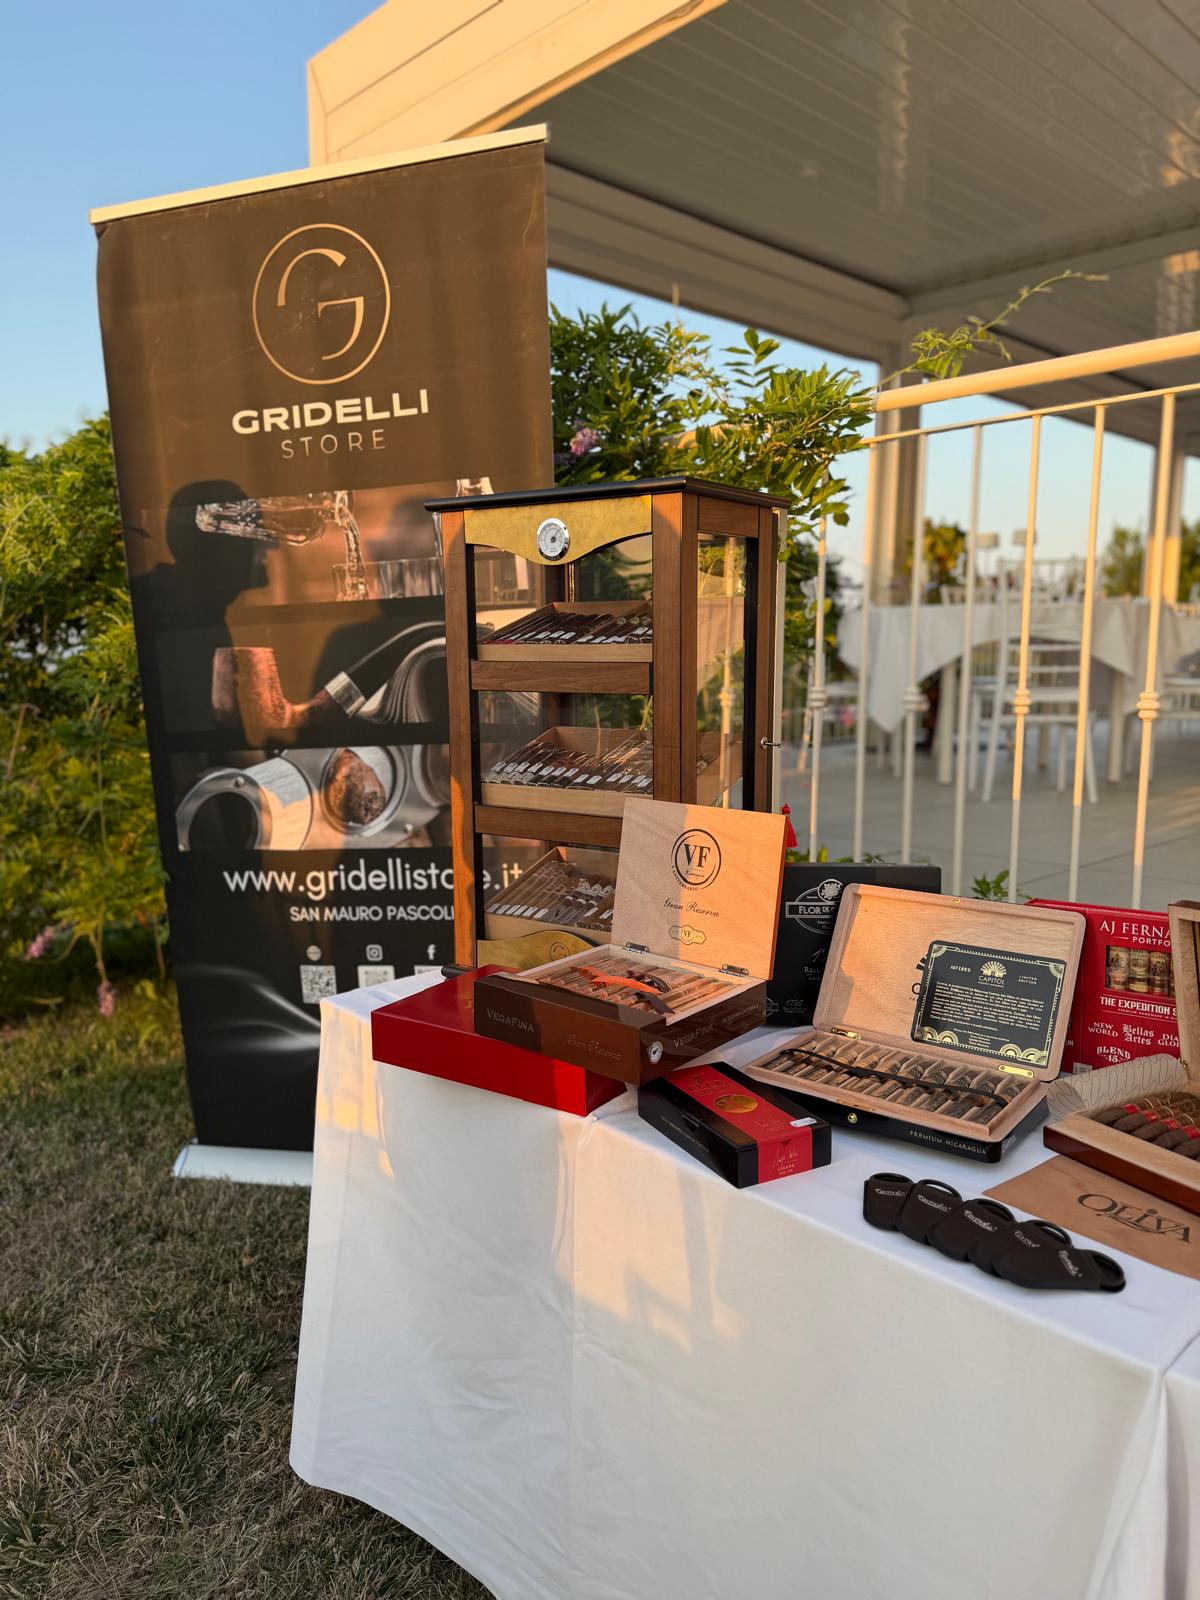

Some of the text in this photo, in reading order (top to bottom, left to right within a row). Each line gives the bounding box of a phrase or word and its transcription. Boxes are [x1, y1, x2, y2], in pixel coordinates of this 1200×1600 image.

[231, 389, 429, 435] GRIDELLI
[280, 429, 386, 459] STORE
[684, 843, 711, 868] VF
[223, 858, 522, 900] www.gridellisto.it
[290, 907, 320, 922] SAN
[323, 906, 383, 921] MAURO
[663, 897, 720, 917] Gran Reserva
[798, 905, 822, 915] FLOR
[1100, 920, 1171, 939] AJ FERNA
[1132, 936, 1171, 947] PORTFO
[978, 975, 1005, 985] CAPITOL
[1100, 996, 1117, 1007] THE
[1118, 999, 1171, 1015] EXPEDITION
[1088, 1027, 1119, 1037] WORLD
[1094, 1022, 1114, 1030] NEW
[1122, 1023, 1154, 1038] Bellas
[1124, 1033, 1152, 1046] Artes
[1096, 1046, 1131, 1060] BLEND
[909, 1130, 943, 1143] PREMIUM
[945, 1140, 987, 1155] NICARAGUA
